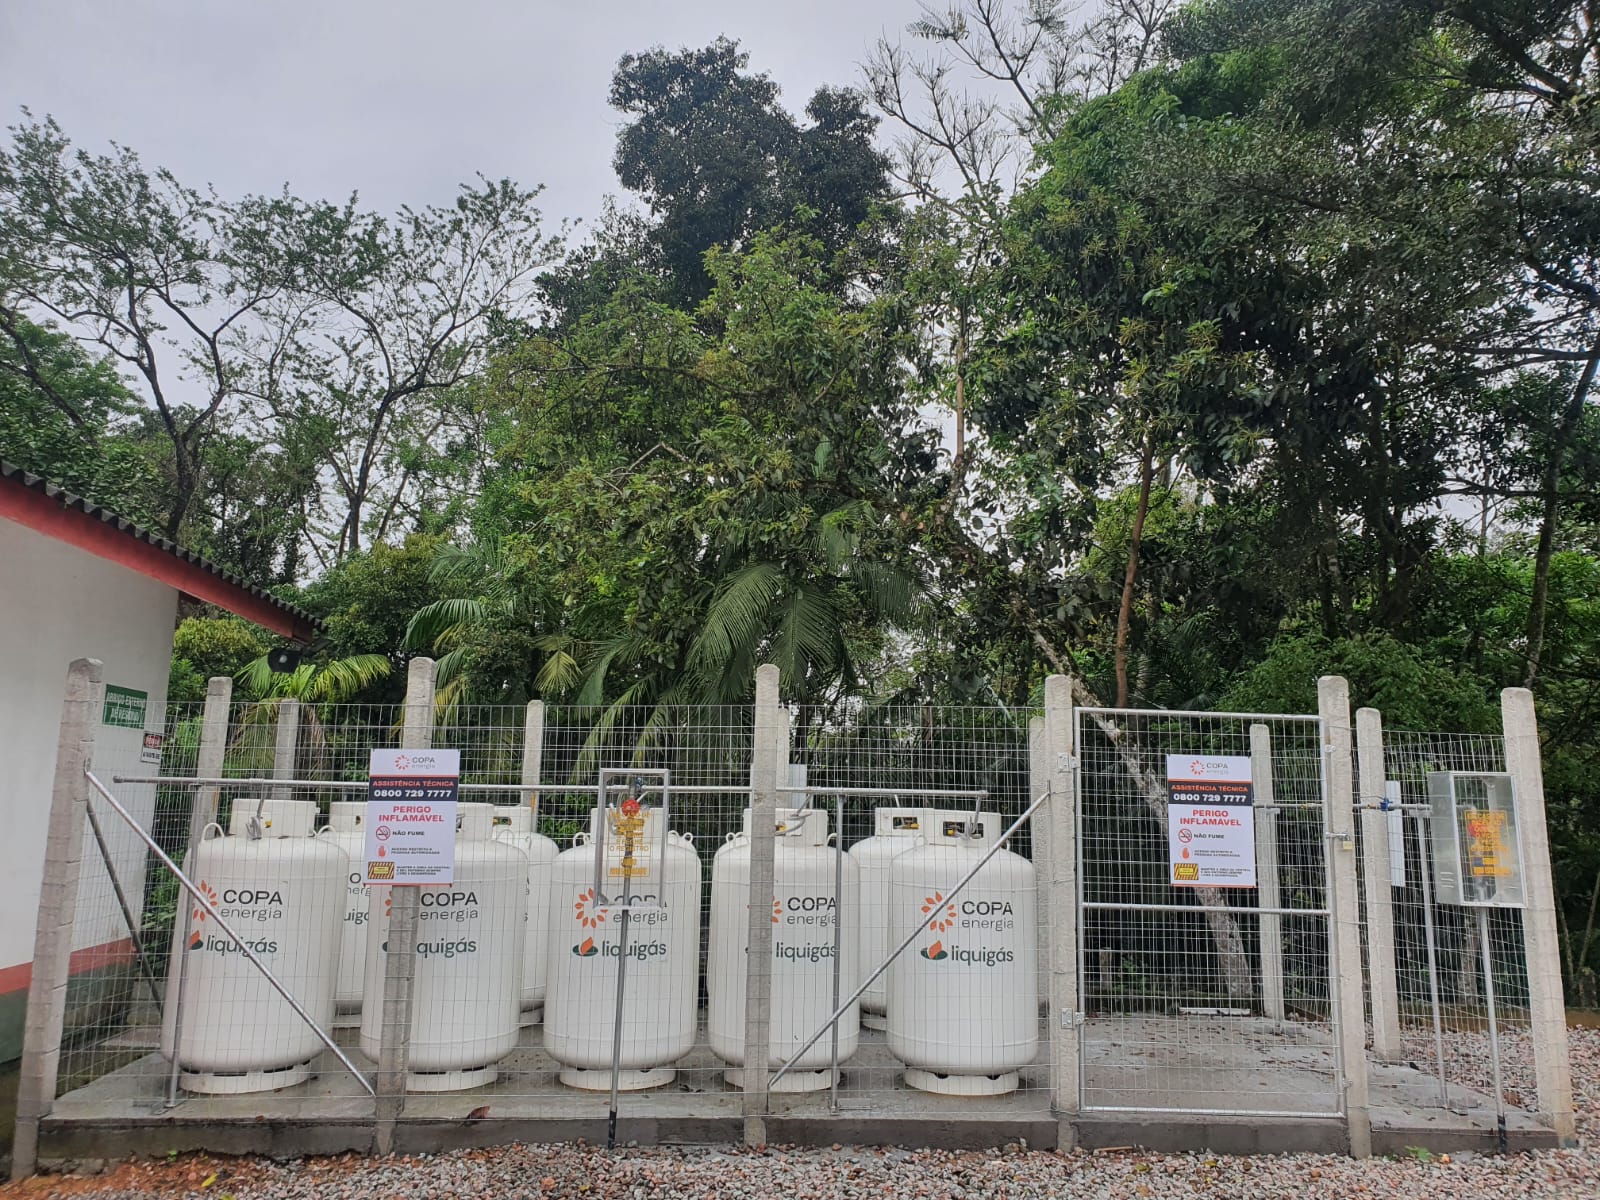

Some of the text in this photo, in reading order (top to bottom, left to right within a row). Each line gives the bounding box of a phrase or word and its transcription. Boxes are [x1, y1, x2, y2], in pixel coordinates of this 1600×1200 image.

[379, 814, 444, 822] INFLAMÁVEL
[1180, 818, 1241, 826] INFLAMÁVEL
[223, 889, 283, 905] COPA
[420, 891, 478, 906] COPA
[787, 897, 836, 911] COPA
[221, 907, 282, 922] energia
[420, 908, 479, 922] energia
[962, 901, 1013, 915] COPA
[962, 917, 1013, 932] energia
[416, 937, 477, 958] quigás
[951, 945, 1013, 967] liquigás
